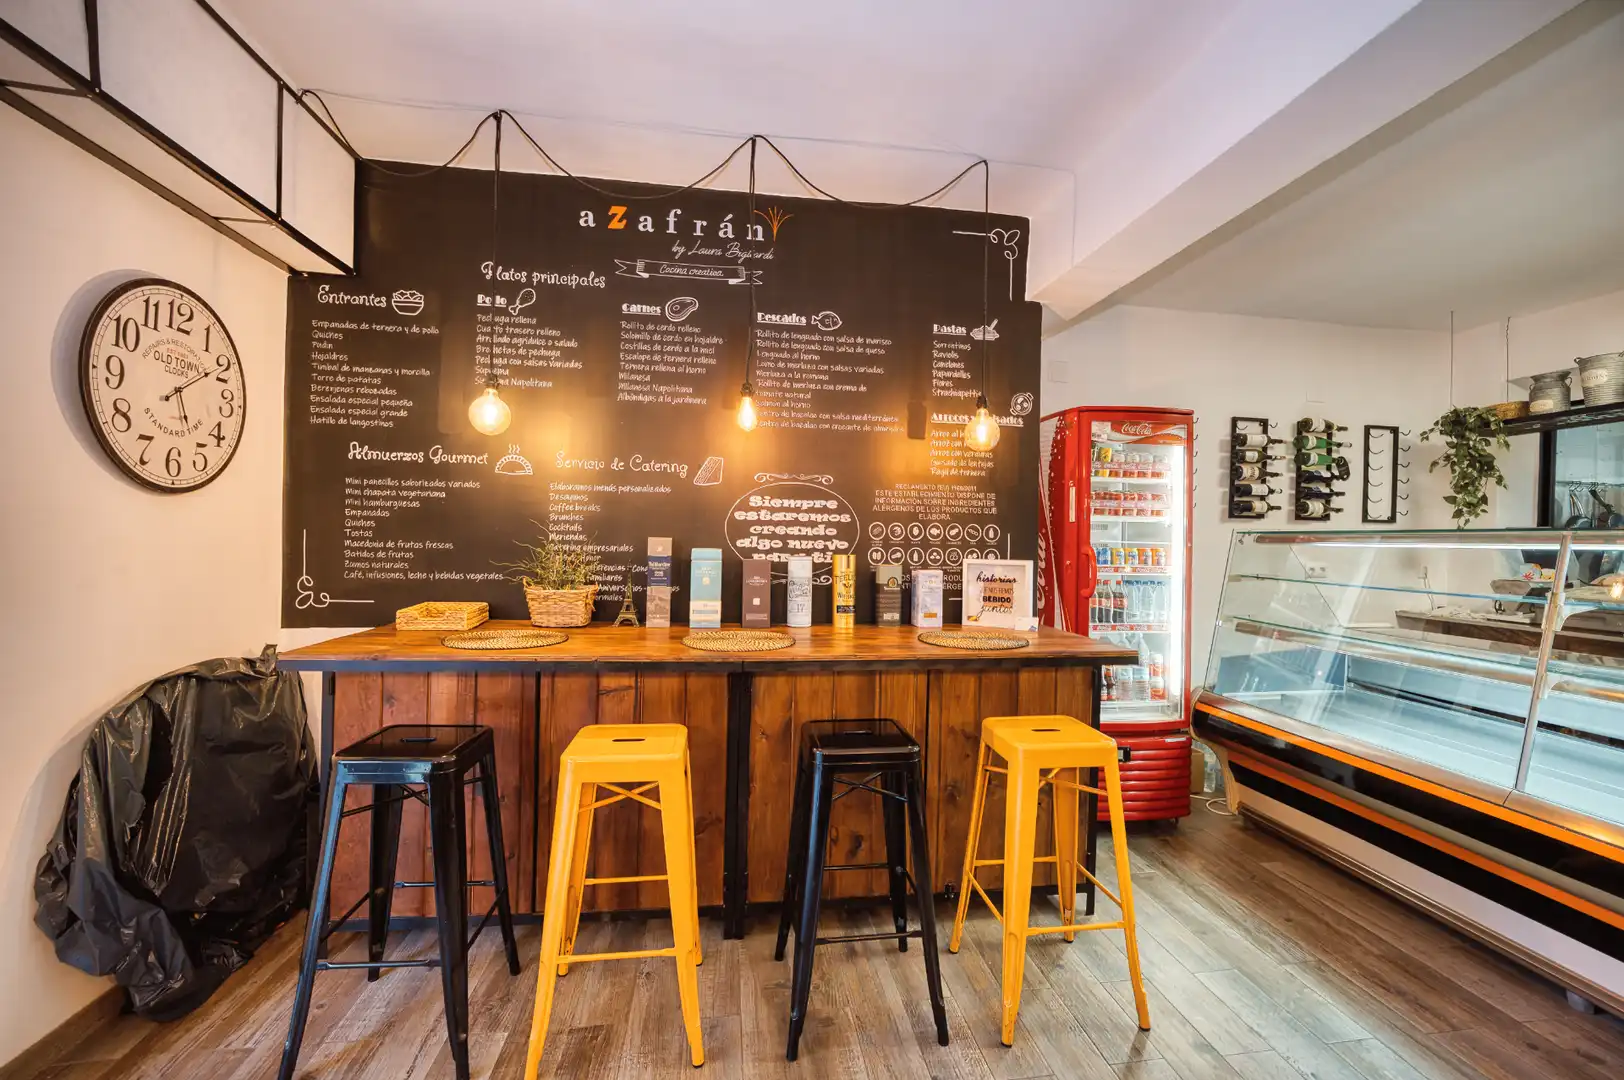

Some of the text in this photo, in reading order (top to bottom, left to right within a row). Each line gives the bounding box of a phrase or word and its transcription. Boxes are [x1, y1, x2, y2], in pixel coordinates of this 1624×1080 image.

[688, 240, 723, 256] Laura
[660, 264, 688, 276] Cocina
[532, 271, 606, 289] principales
[317, 285, 387, 308] Entrantes
[477, 294, 507, 305] Polo
[141, 296, 160, 332] 11
[166, 298, 195, 336] 12
[510, 316, 537, 325] rellena
[111, 314, 141, 352] 10
[312, 320, 439, 335] Empanadas ternera pollo
[505, 327, 561, 337] trasero relleno
[620, 321, 701, 333] Rollito cerdo relleno
[933, 324, 967, 335] Pastas
[202, 324, 212, 354] 1
[312, 330, 343, 340] Quiches
[620, 332, 651, 341] Solomillo
[694, 335, 724, 345] hojaldre
[756, 330, 892, 345] Rollito lenguado salsa marisco
[512, 337, 579, 348] agridulce salado
[620, 342, 683, 353] Costillas cerdo
[756, 340, 780, 349] Rollito
[791, 342, 822, 352] lenguado
[836, 345, 855, 353] salsa
[933, 340, 972, 351] Sorrentinos
[311, 352, 349, 362] Hojaldres
[528, 348, 561, 359] pechuga
[620, 353, 717, 365] Escalope ternera relleno
[800, 353, 821, 361] horno
[932, 350, 959, 359] Raviolis
[153, 350, 173, 365] OLD
[174, 356, 200, 375] TOWN
[523, 358, 583, 370] salsas variadas
[620, 363, 706, 374] Ternera rellena horno
[757, 360, 884, 375] Lomo merluza salsas variadas
[105, 354, 125, 390] 9
[164, 364, 189, 379] CLOCKS
[215, 354, 231, 384] 2
[311, 362, 339, 372] Timbal
[401, 368, 431, 377] morcilla
[311, 373, 382, 386] Torre patatas
[618, 371, 651, 382] Milanesa
[618, 382, 651, 392] Milanesa
[932, 379, 954, 388] Flores
[218, 389, 234, 418] 3
[310, 395, 413, 408] Ensalada especial pequeña
[111, 397, 132, 433] 8
[310, 406, 408, 419] Ensalada especial grande
[144, 407, 204, 438] STANDARD TIME
[310, 417, 394, 429] Hatillo langostinos
[208, 421, 226, 448] 4
[136, 433, 154, 466] 7
[348, 441, 489, 465] Almuerzos Gourmet
[165, 447, 181, 478] 6
[193, 442, 208, 472] 5
[556, 450, 689, 479] Servicio de Catering
[345, 477, 481, 489] Mini panecillos saborizados variados
[549, 481, 672, 494] Elaboramos menús personalizados
[345, 487, 446, 500] Mini chapata vegetariana
[549, 493, 589, 502] Desayunos
[894, 491, 985, 500] ESTABLECIMIENTO DISPONE
[345, 498, 420, 509] Mini hamburguesas
[549, 503, 575, 512] Coffee
[749, 495, 839, 511] Siempre
[923, 498, 946, 506] SOBRE
[344, 509, 390, 519] Empanadas
[549, 513, 584, 521] Brunches
[734, 510, 852, 523] estaremos
[344, 518, 376, 528] Quiches
[549, 523, 583, 532] Cocktails
[344, 528, 373, 537] Tostas
[750, 525, 837, 536] creando
[549, 532, 588, 542] Meriendas
[736, 536, 849, 550] algo nuevo
[344, 539, 454, 550] Macedonia frutas frescas
[583, 543, 634, 553] empresariales
[344, 549, 414, 560] Batidos frutas
[344, 560, 409, 570] Zumos naturales
[407, 571, 427, 580] leche
[435, 572, 464, 581] bebidas
[465, 572, 503, 583] vegetales
[976, 571, 1017, 583] historias
[983, 595, 1012, 603] BEBIDO
